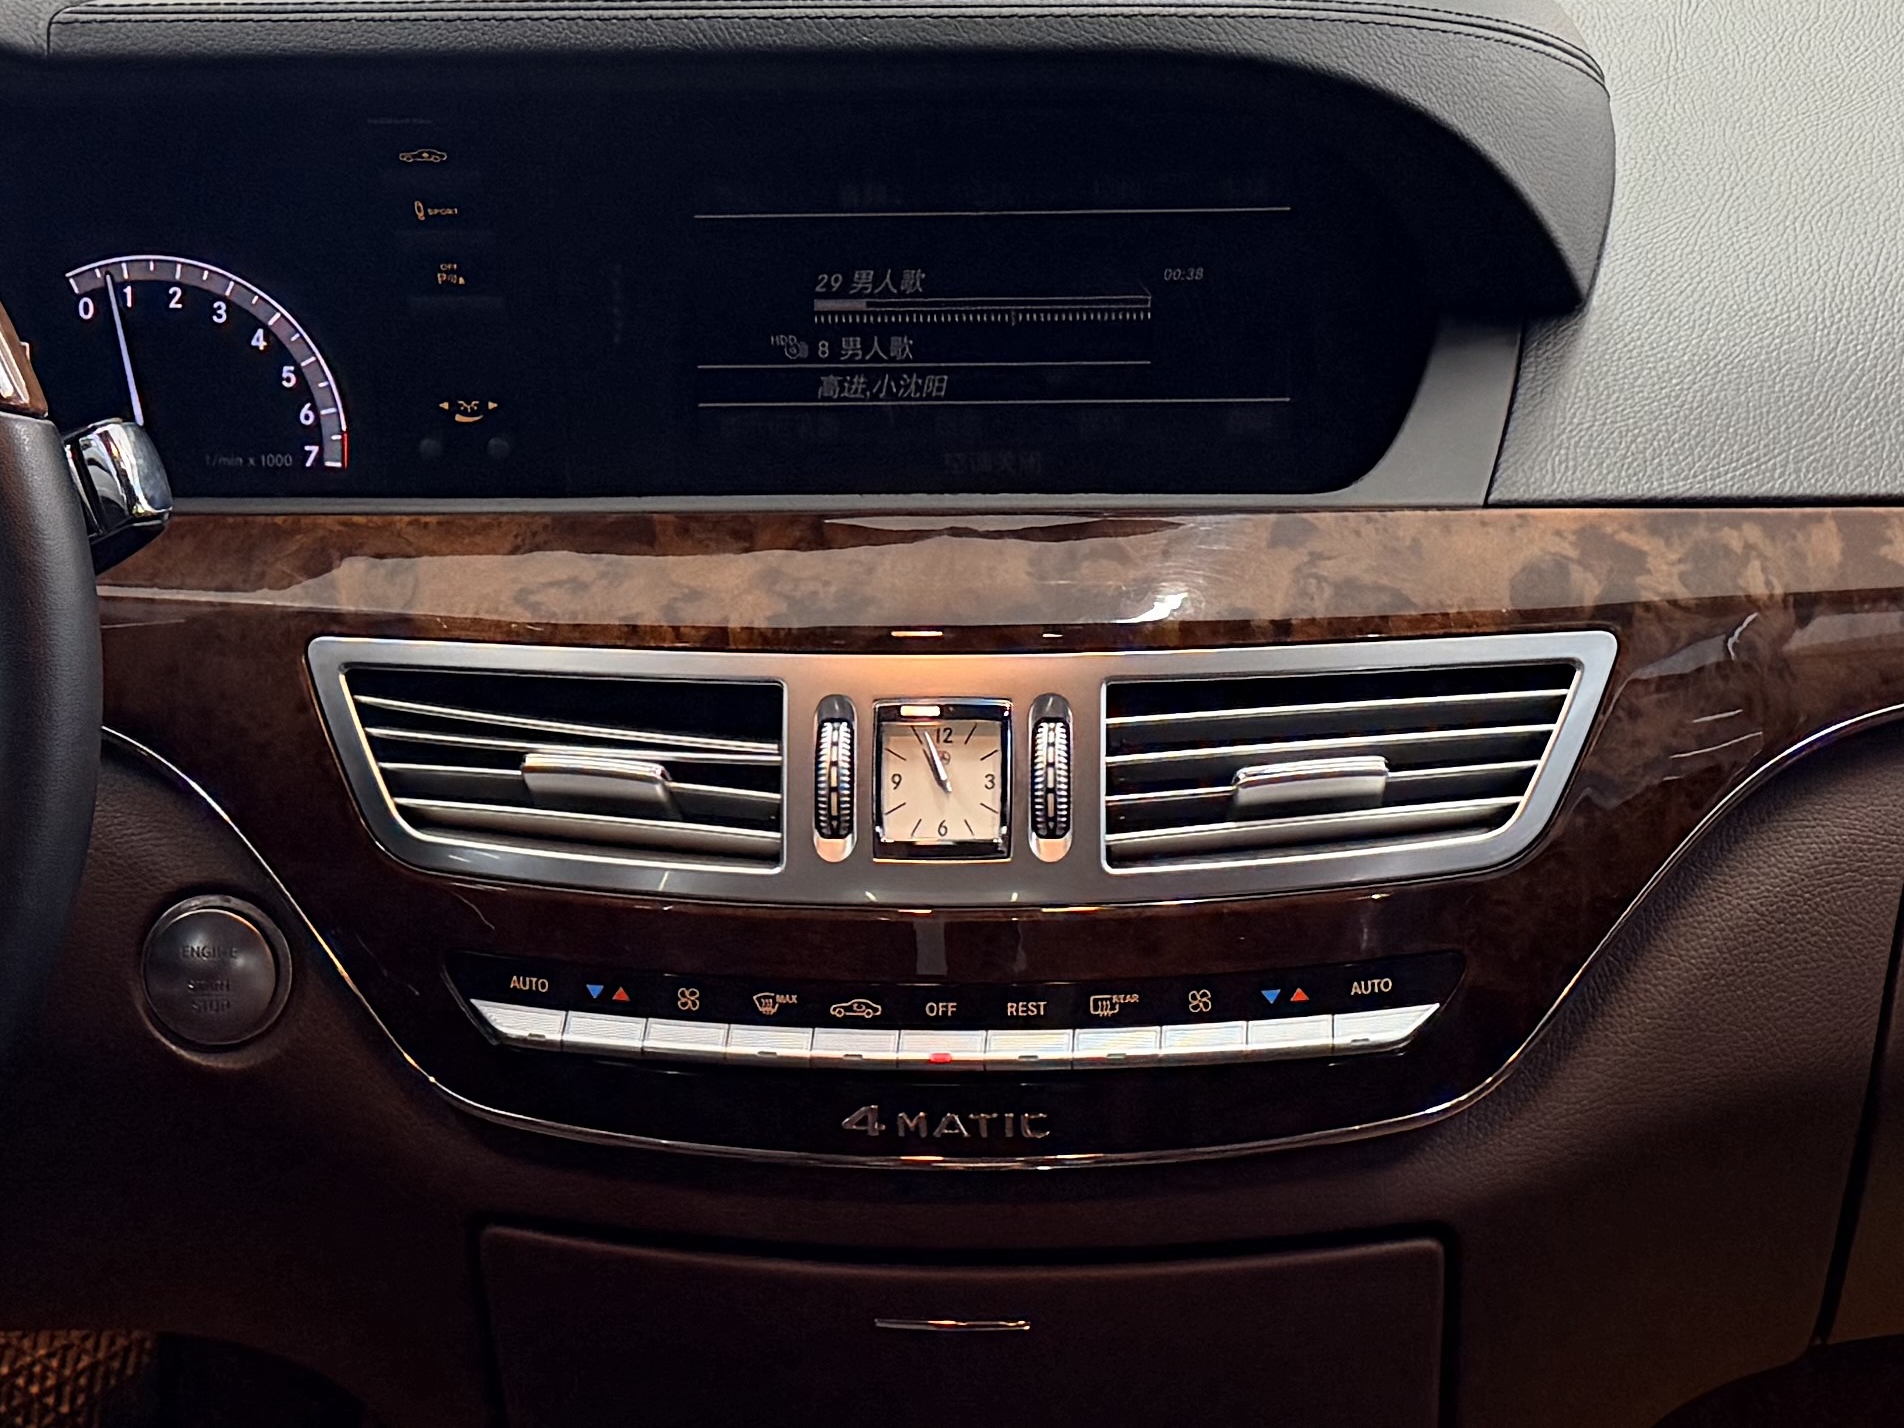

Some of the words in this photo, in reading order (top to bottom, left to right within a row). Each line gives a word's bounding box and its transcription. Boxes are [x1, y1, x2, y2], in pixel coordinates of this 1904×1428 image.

[815, 274, 843, 293] 29
[849, 269, 926, 294] 男人歌
[1163, 267, 1205, 281] 00:38
[122, 285, 133, 308] 1
[168, 286, 183, 309] 2
[78, 297, 95, 320] 0
[212, 300, 228, 323] 3
[250, 328, 268, 350] 4
[817, 341, 829, 358] 8
[839, 335, 914, 360] 男人歌
[281, 366, 297, 388] 5
[817, 374, 949, 400] 高进,小沈阳
[299, 402, 315, 425] 6
[260, 452, 294, 468] 1000
[303, 445, 320, 468] 7
[934, 726, 954, 745] 12
[890, 772, 903, 790] 9
[984, 773, 996, 790] 3
[937, 819, 949, 837] 6
[509, 974, 550, 993] AUTO
[1350, 977, 1392, 996] AUTO
[776, 993, 798, 1005] MAX
[1112, 992, 1139, 1004] REAR
[925, 1001, 957, 1018] OFF
[1006, 1001, 1047, 1017] REST
